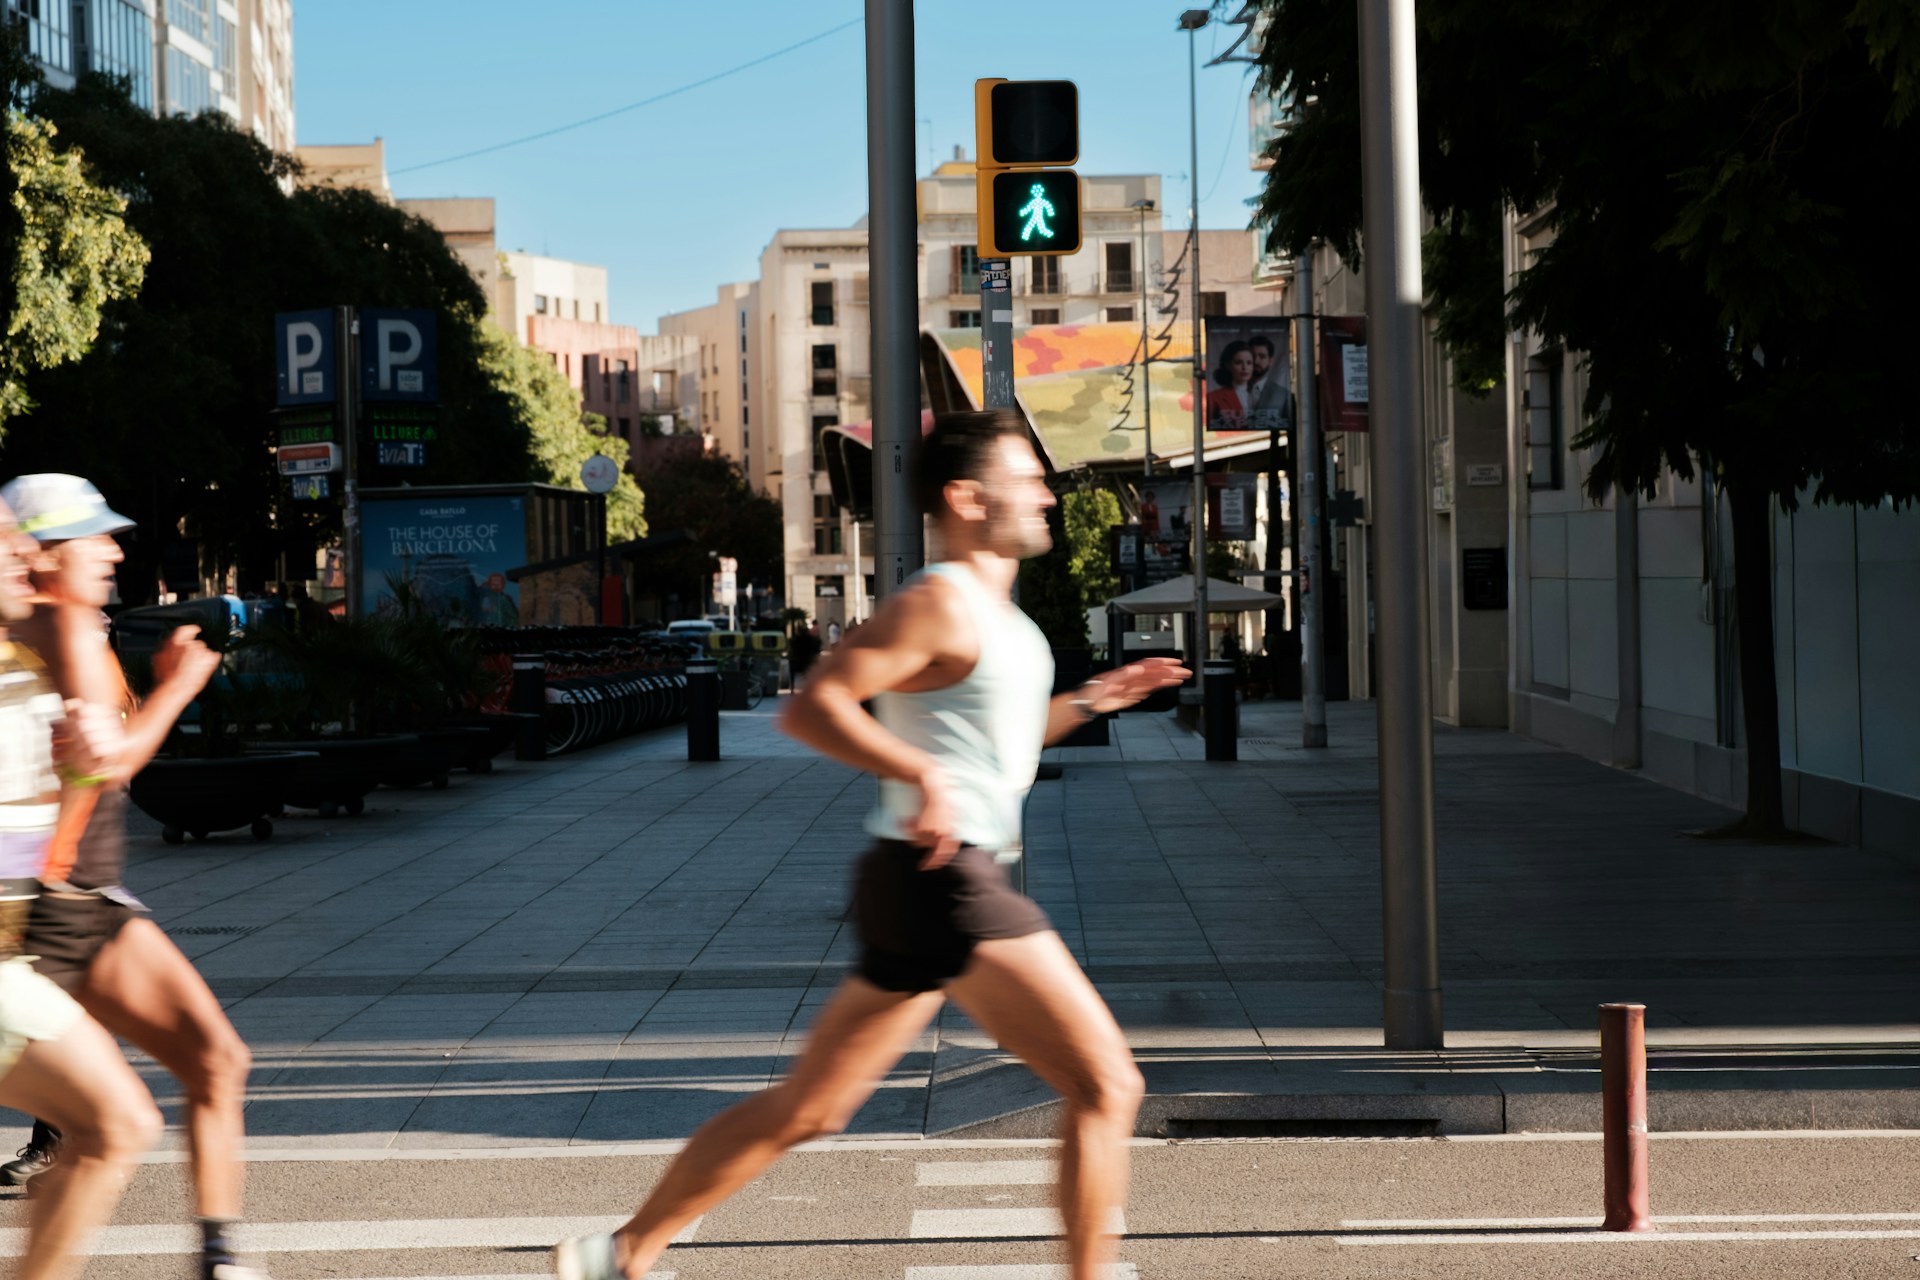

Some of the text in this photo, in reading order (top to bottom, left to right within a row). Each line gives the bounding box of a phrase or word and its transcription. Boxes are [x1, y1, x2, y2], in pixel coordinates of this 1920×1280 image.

[287, 321, 323, 395] P
[377, 318, 423, 391] P
[283, 427, 320, 443] LLIURE
[373, 425, 421, 440] LLIURE
[419, 507, 438, 516] CASA
[388, 523, 499, 541] THE HOUSE OF
[391, 538, 498, 556] BARCELONA
